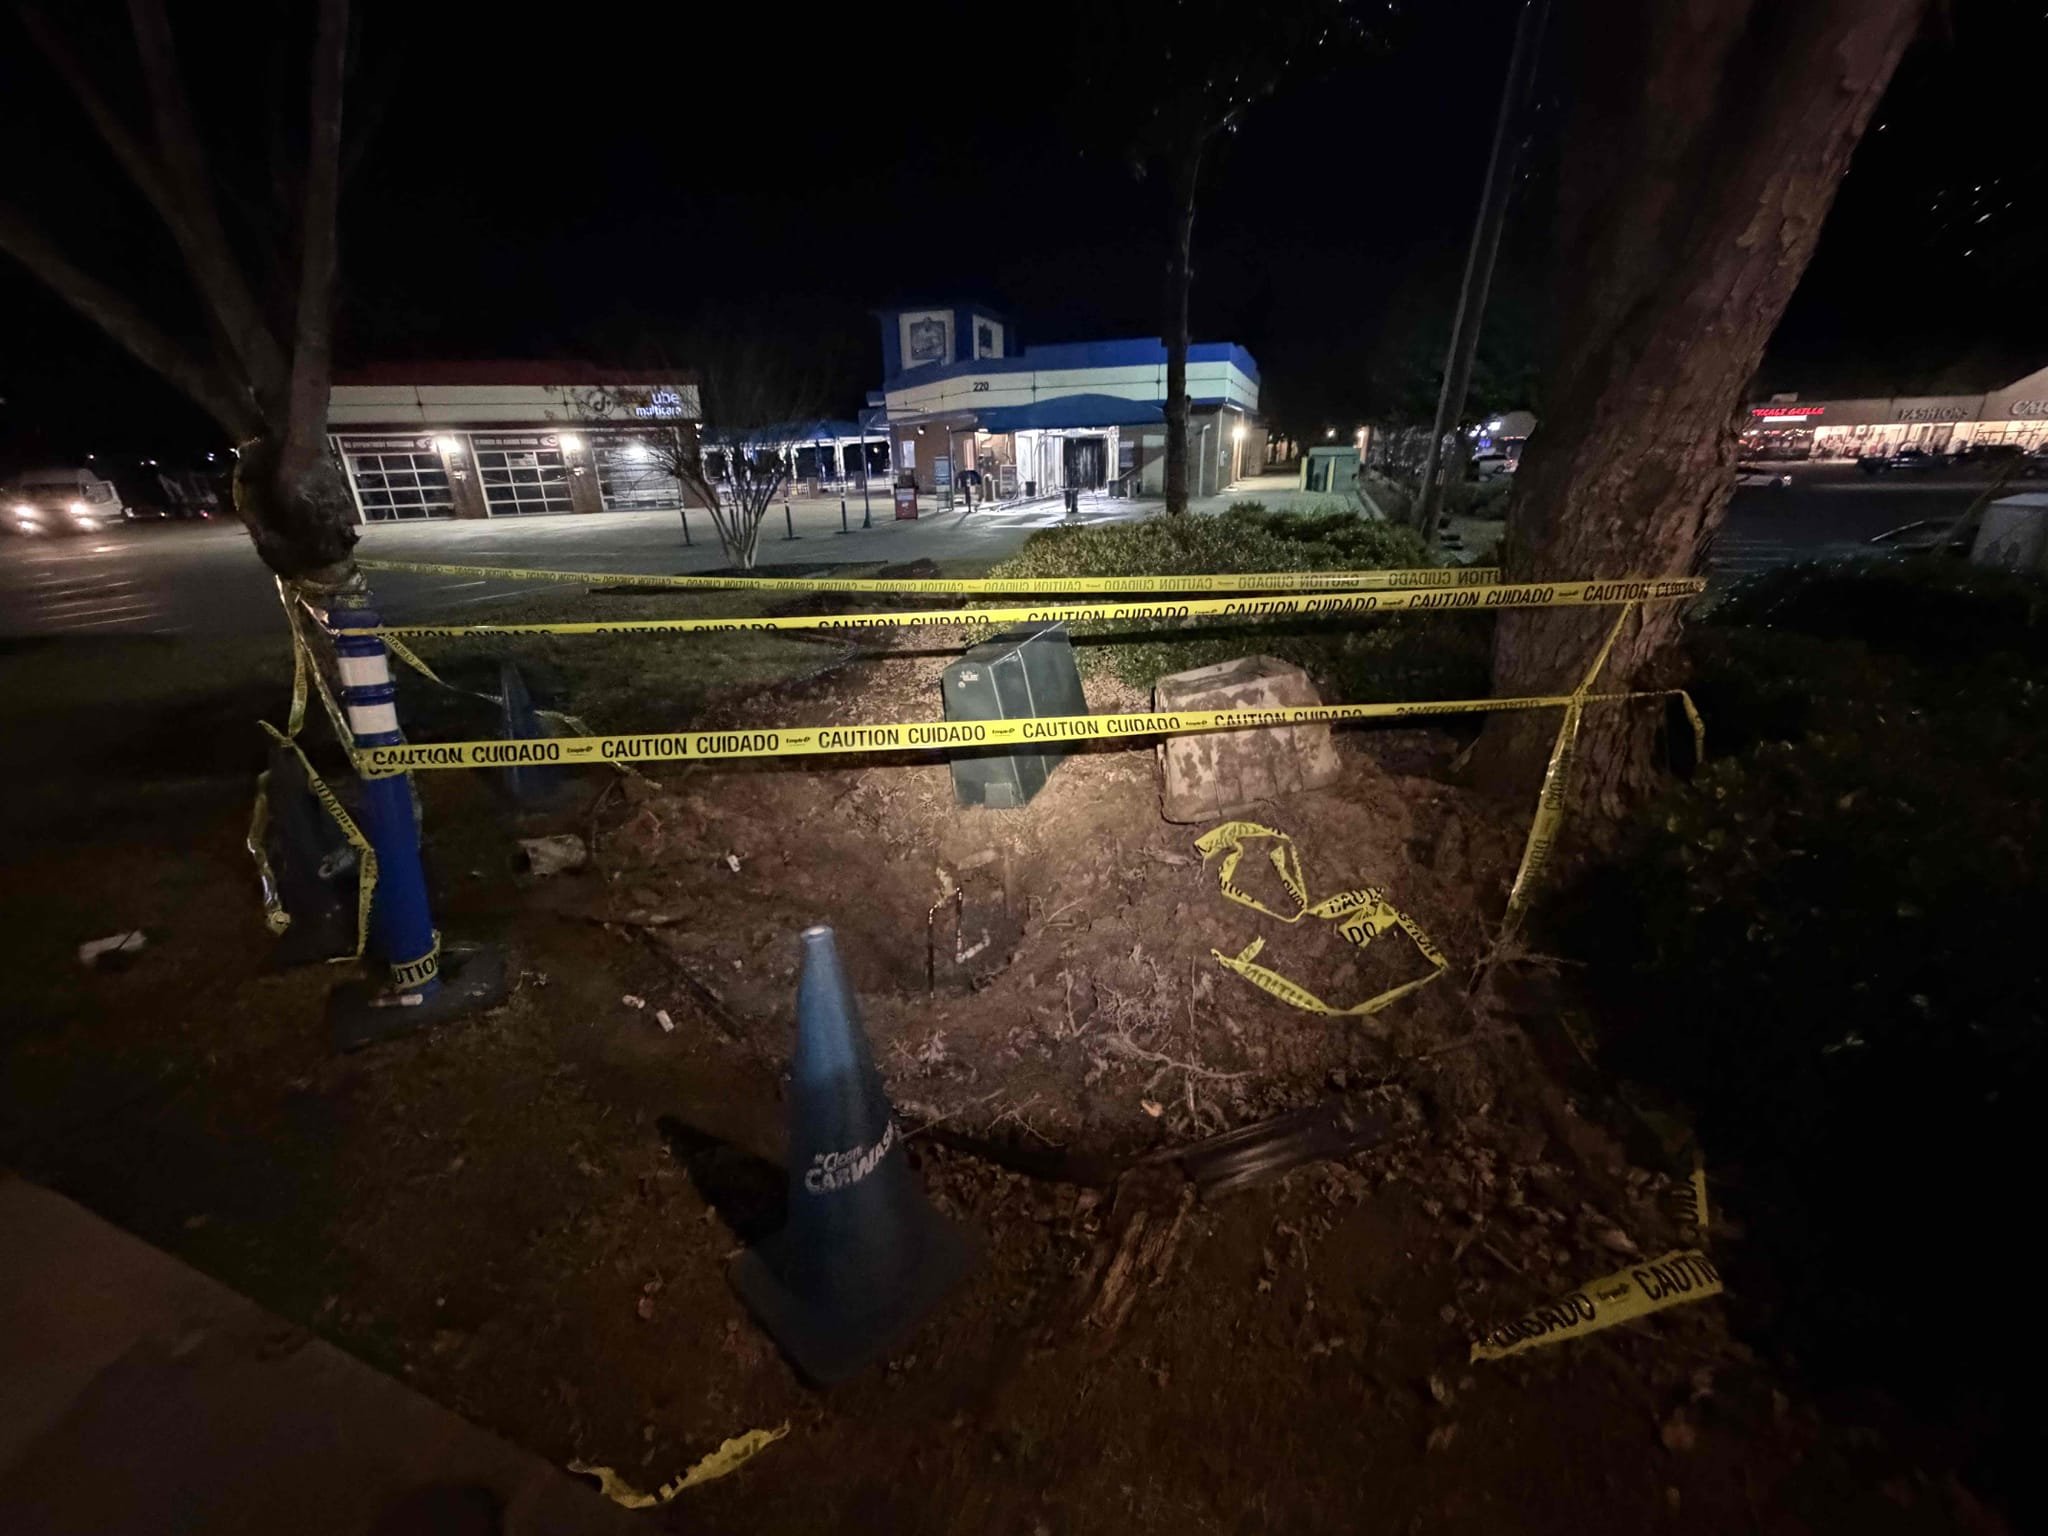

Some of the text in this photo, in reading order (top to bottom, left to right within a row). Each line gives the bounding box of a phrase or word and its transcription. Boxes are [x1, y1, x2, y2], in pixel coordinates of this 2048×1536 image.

[973, 381, 990, 393] 220
[651, 391, 680, 404] ube
[1897, 407, 1969, 421] FASHIONS
[1224, 600, 1299, 615] CAUTION
[1304, 597, 1377, 613] CUIDADO
[1408, 591, 1481, 608] CAUTION
[1485, 587, 1554, 605] CUIDADO
[1583, 583, 1649, 601] CAUTION
[471, 743, 559, 764] CUIDADO
[601, 737, 687, 758] CAUTION
[695, 733, 780, 755] CUIDADO
[818, 728, 901, 750] CAUTION
[907, 725, 985, 745] CUIDADO
[1022, 719, 1099, 739] CAUTION
[1107, 716, 1182, 734] CUIDADO
[1347, 921, 1378, 945] DO
